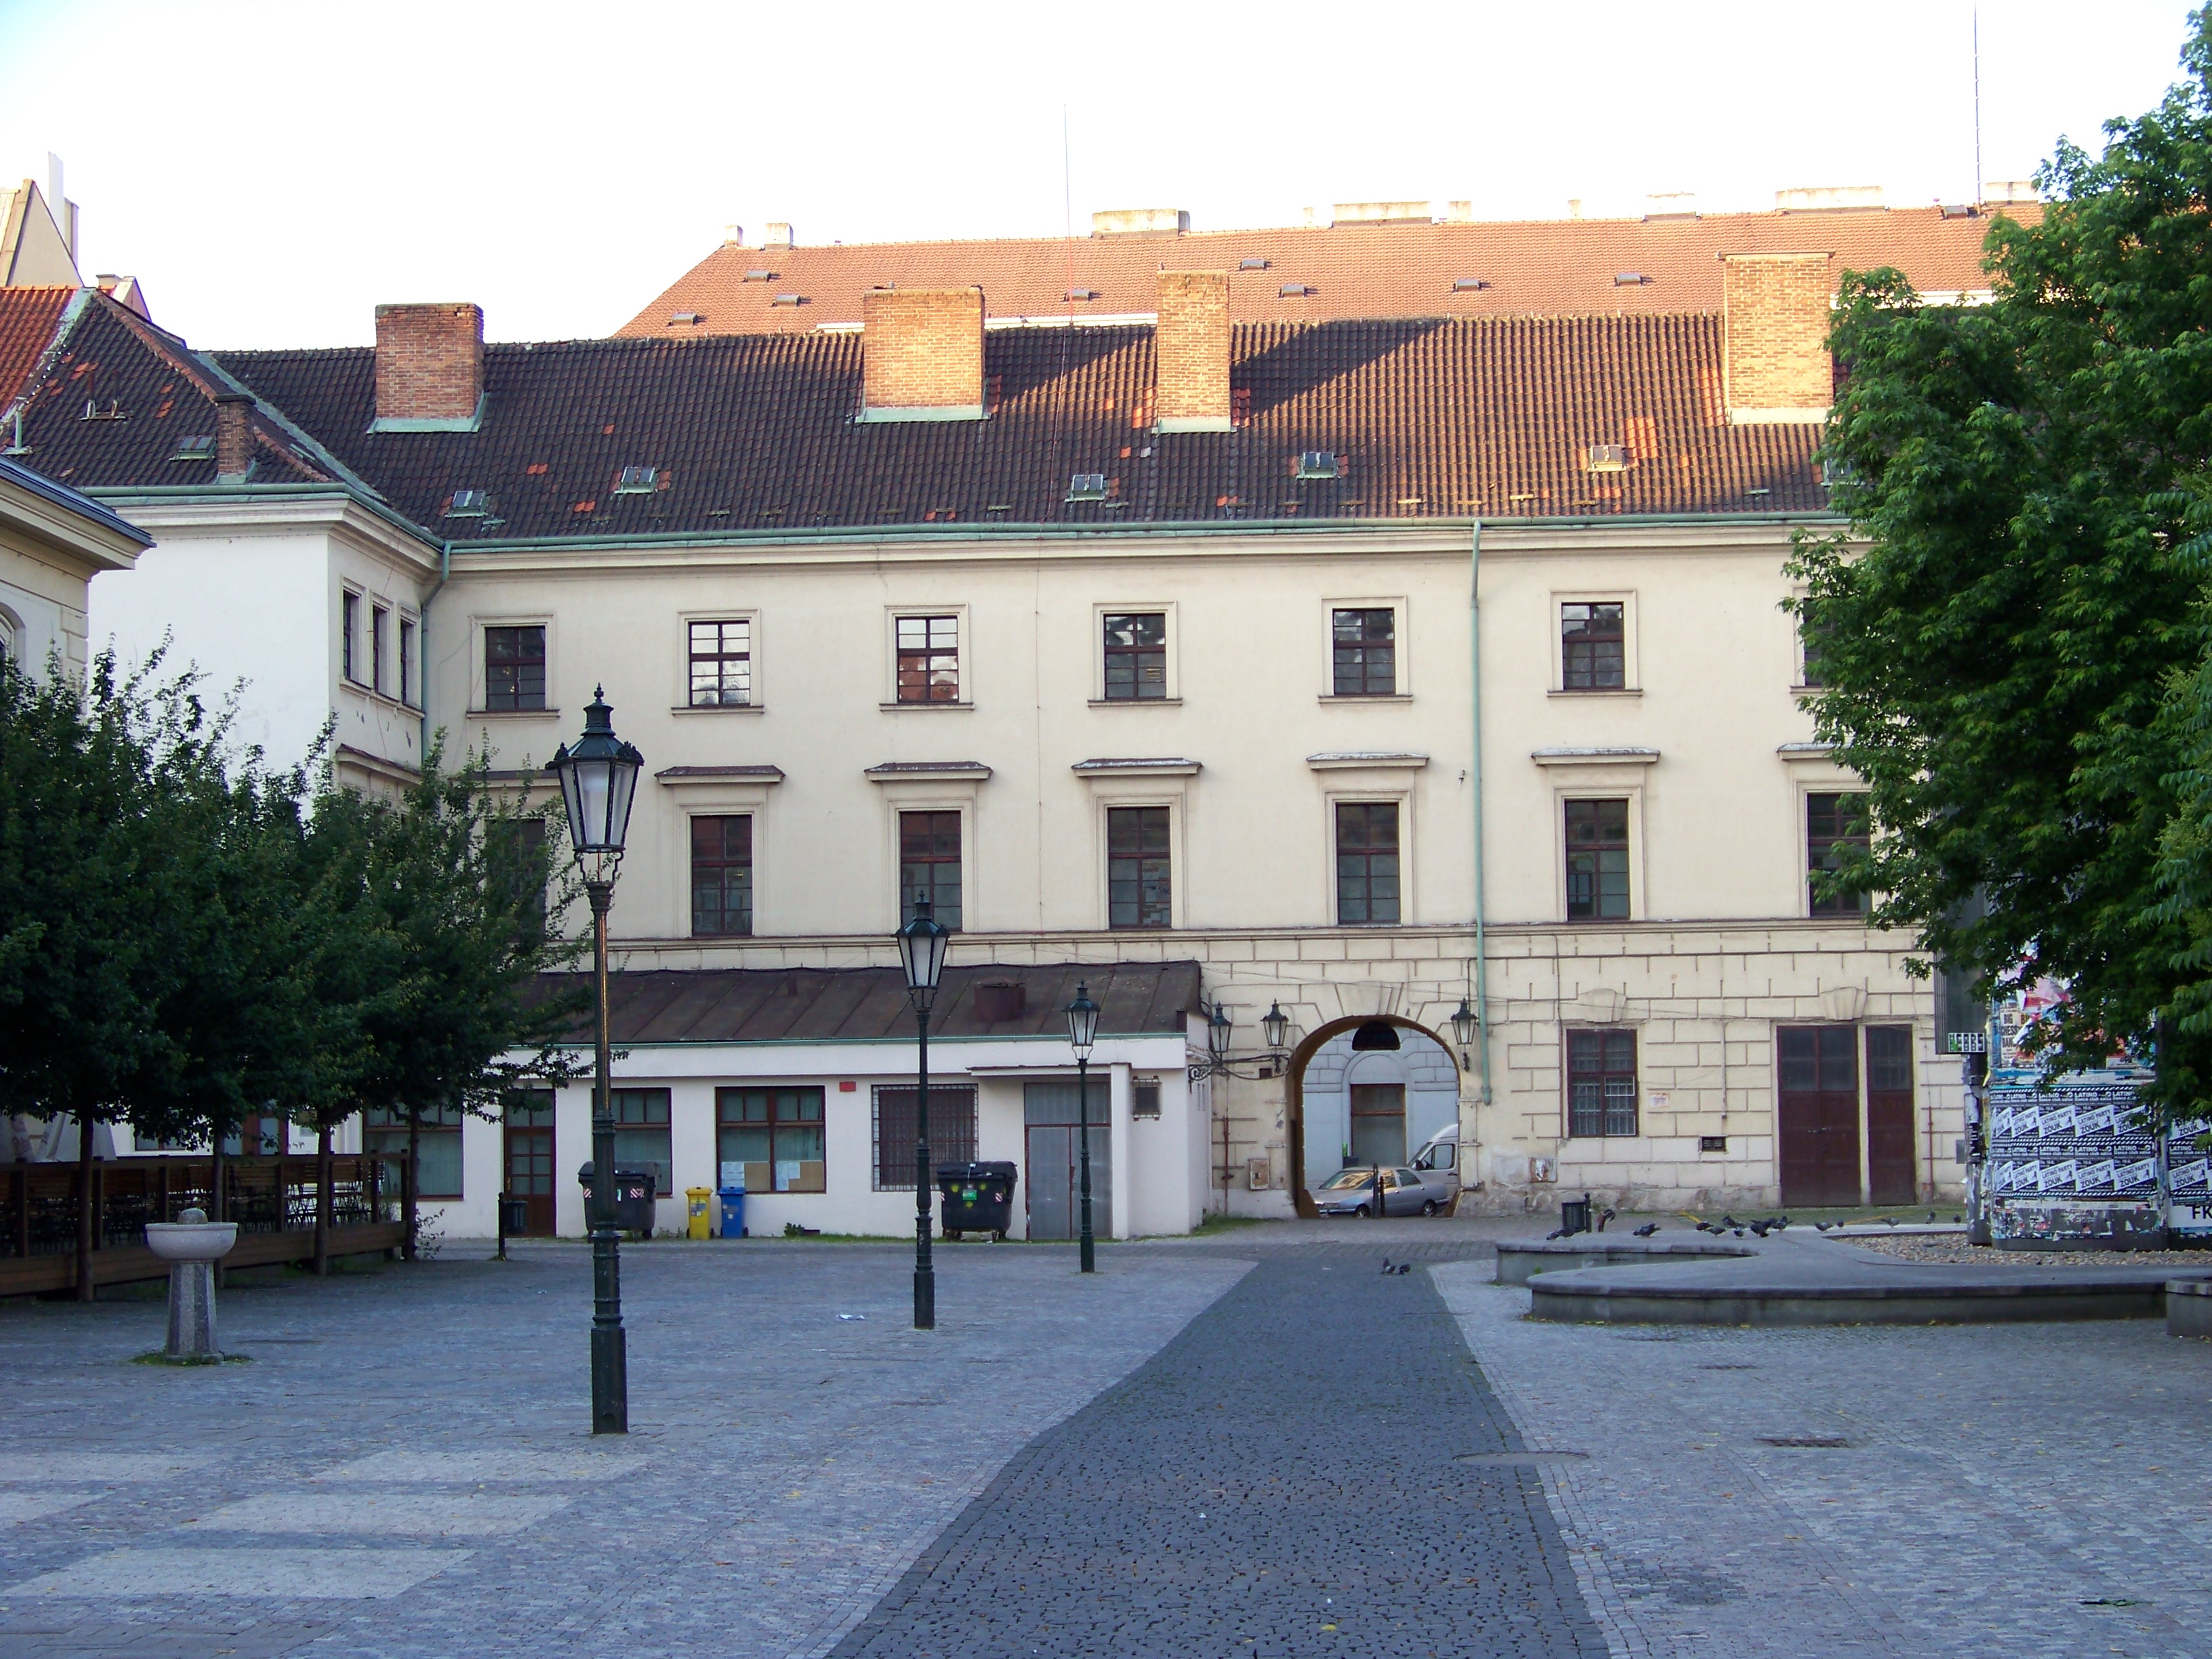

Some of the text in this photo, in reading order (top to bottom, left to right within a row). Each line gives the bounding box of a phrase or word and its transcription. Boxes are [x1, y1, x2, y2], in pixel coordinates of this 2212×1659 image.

[2078, 1109, 2110, 1125] LATINO PARTY
[2044, 1122, 2062, 1134] ZOUK
[2080, 1121, 2100, 1134] ZOUK
[2178, 1124, 2200, 1136] ZOUK
[2078, 1164, 2110, 1179] LATINO PARTY
[2117, 1163, 2150, 1178] LATINO PARTY
[2173, 1162, 2205, 1179] LATINO PARTY
[2044, 1176, 2063, 1187] ZOUK
[2080, 1175, 2101, 1188] ZOUK
[2119, 1174, 2139, 1187] ZOUK
[2175, 1174, 2196, 1187] ZOUK
